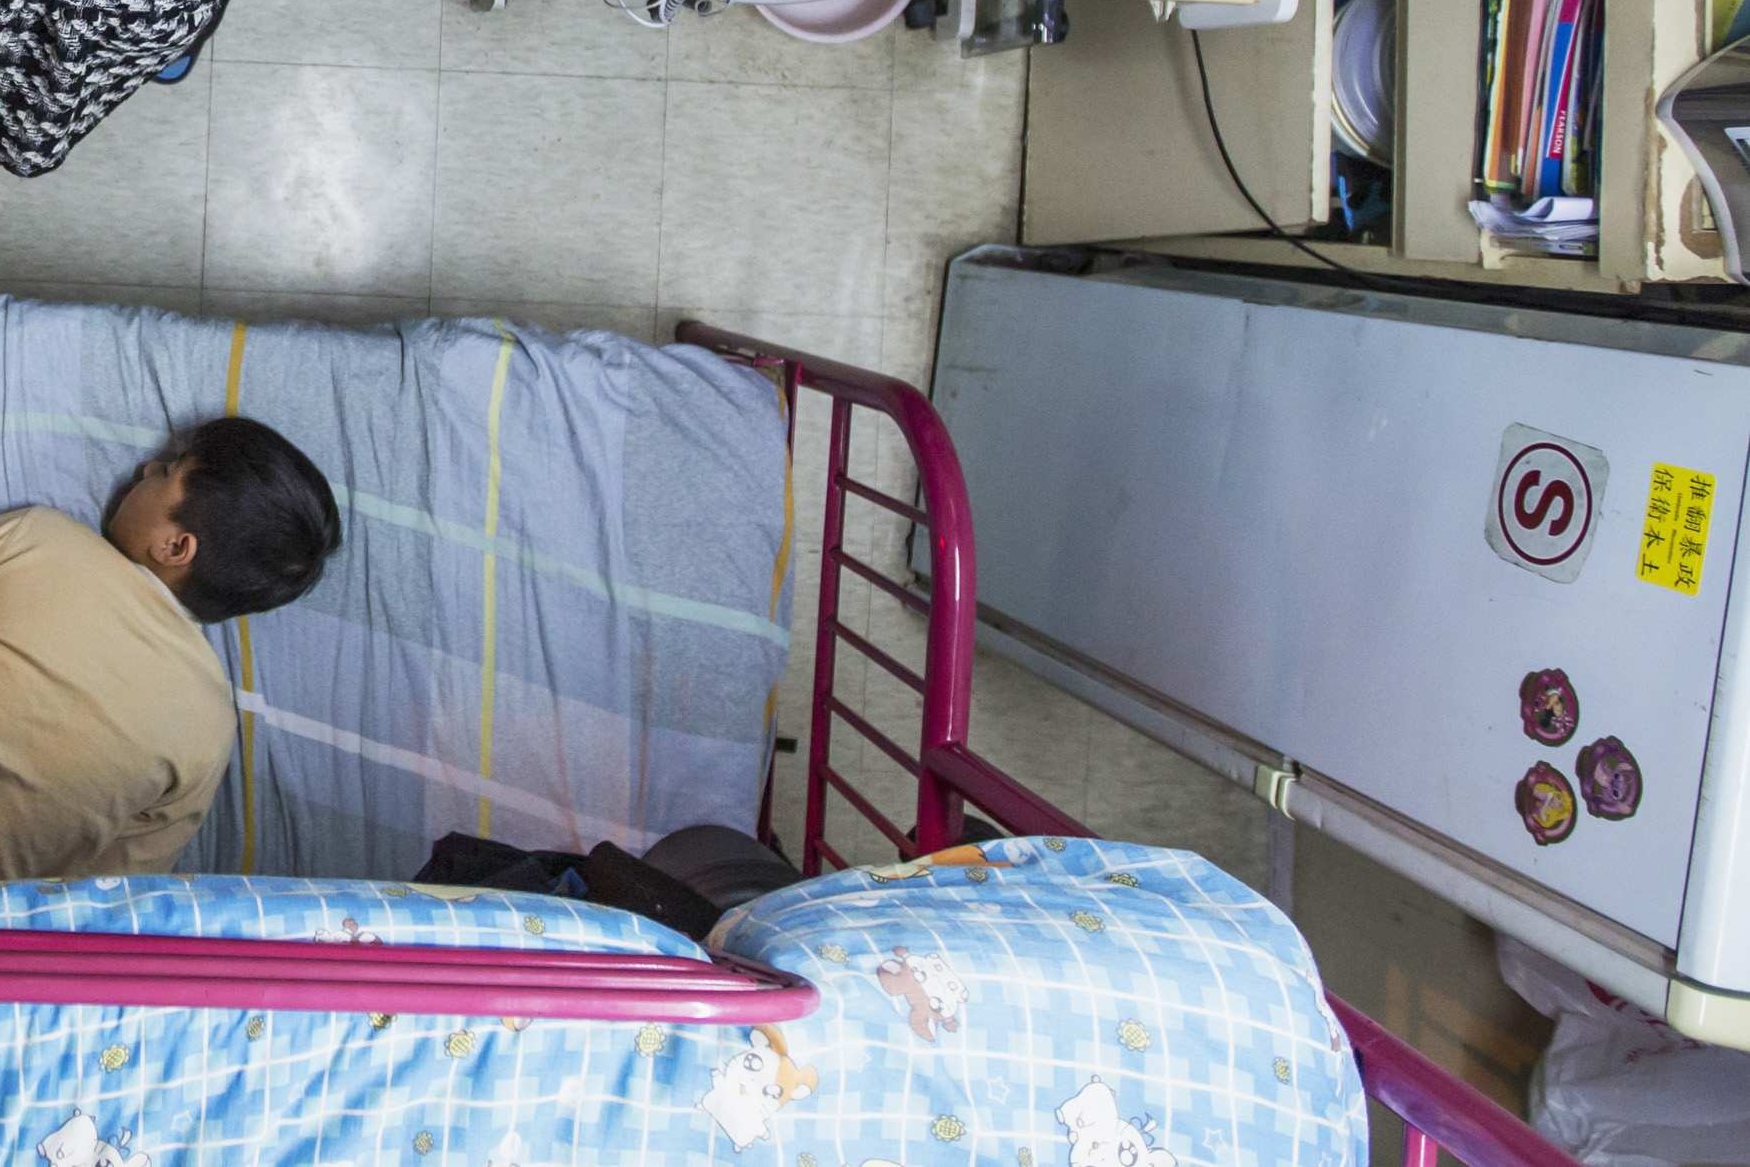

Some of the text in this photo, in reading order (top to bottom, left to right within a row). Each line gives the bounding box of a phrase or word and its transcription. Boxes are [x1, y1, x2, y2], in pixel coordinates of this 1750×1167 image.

[1553, 110, 1567, 154] PEARSON
[1514, 469, 1575, 537] S
[1640, 469, 1675, 576] 保衛本土
[1674, 474, 1712, 588] 推翻暴政
